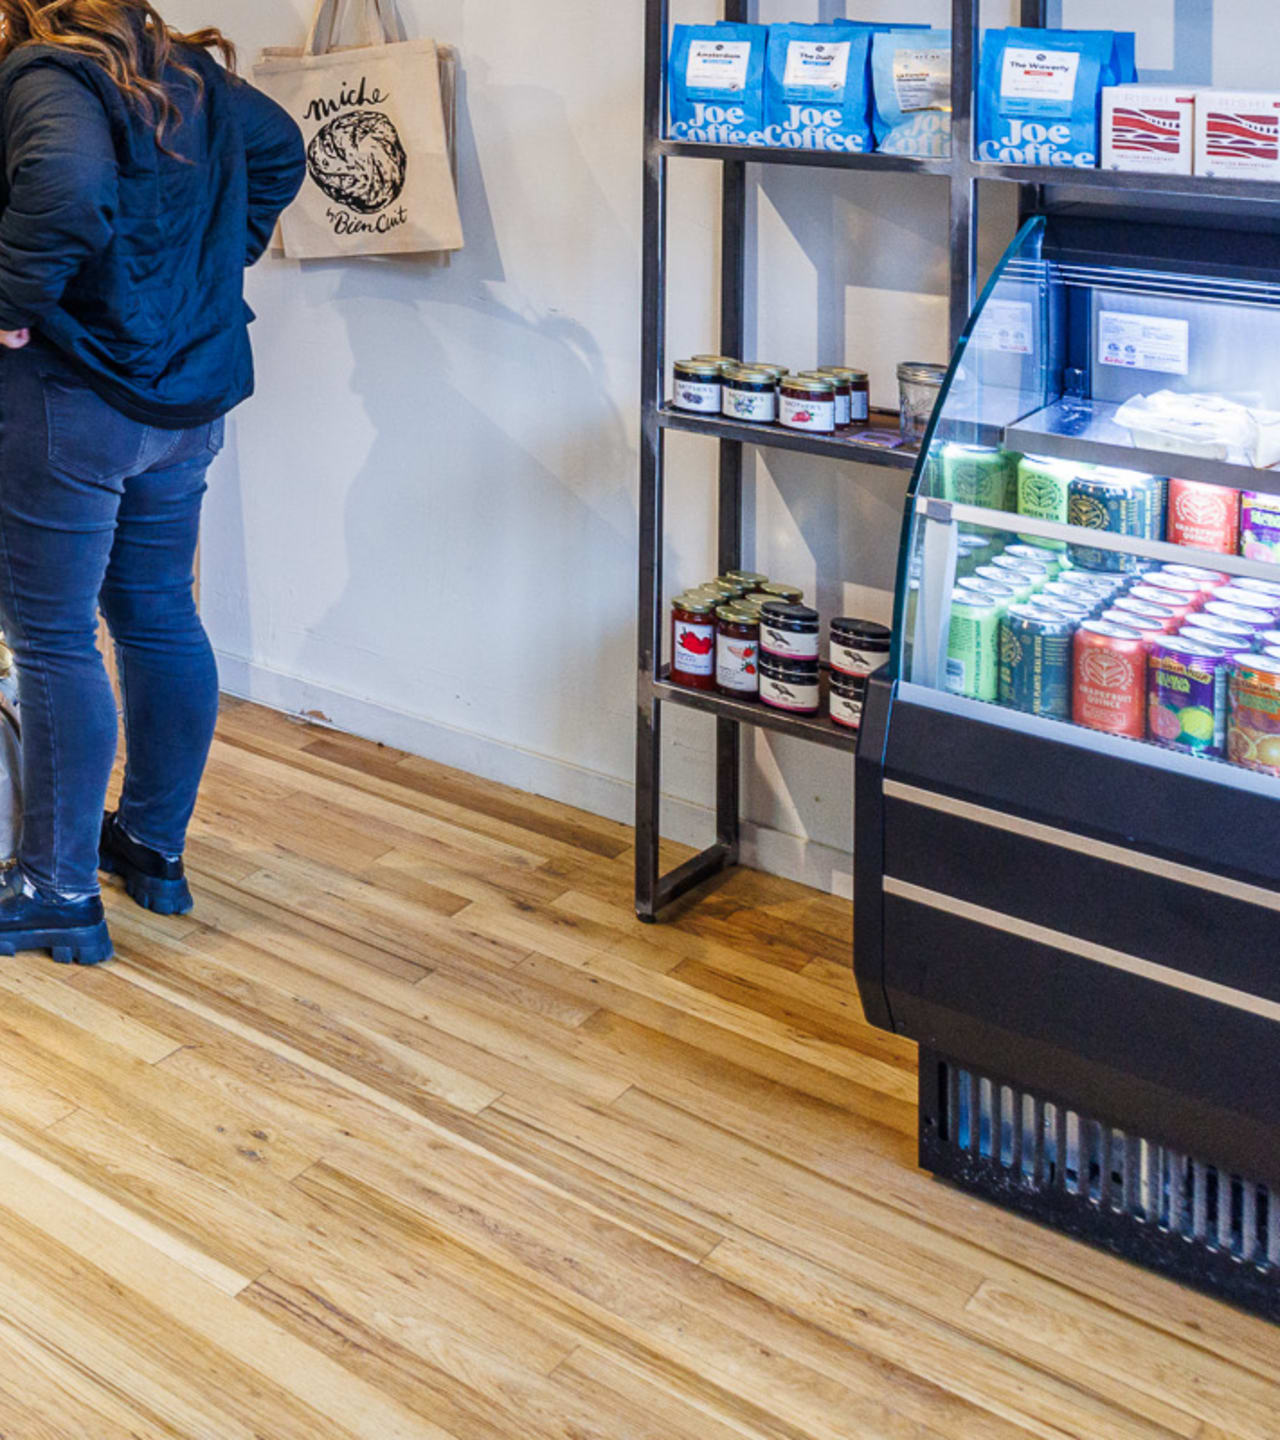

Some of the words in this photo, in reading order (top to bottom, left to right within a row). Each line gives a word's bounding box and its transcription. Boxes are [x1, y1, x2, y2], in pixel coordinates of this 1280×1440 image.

[303, 77, 390, 121] miche
[688, 103, 746, 127] Joe
[783, 104, 844, 132] Joe
[763, 123, 866, 152] Coffee
[1000, 120, 1072, 146] Joe
[978, 140, 1096, 170] Coffee
[334, 212, 378, 236] Bien
[376, 207, 409, 234] Cuit
